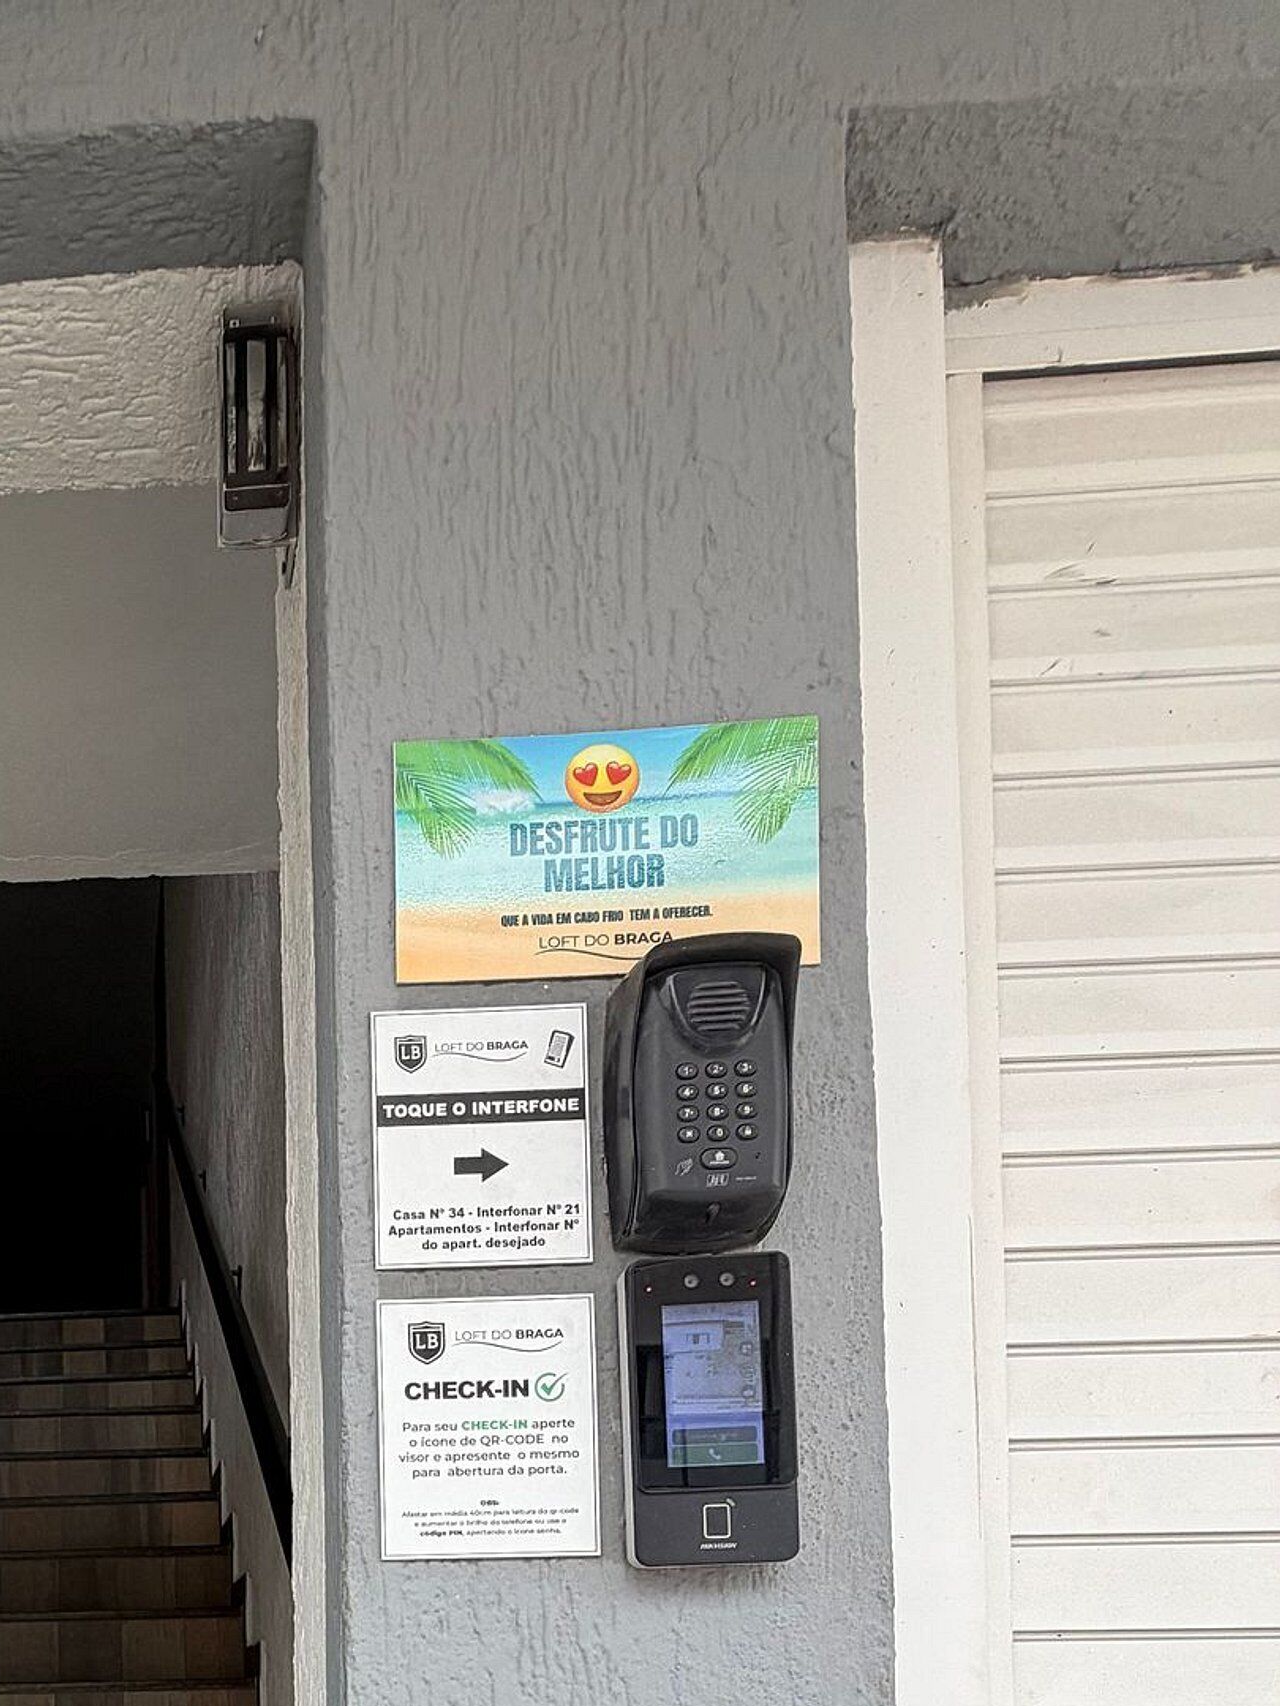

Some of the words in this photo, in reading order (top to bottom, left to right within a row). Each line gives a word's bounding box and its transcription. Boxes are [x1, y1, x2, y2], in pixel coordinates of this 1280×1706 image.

[510, 816, 651, 857] DESFRUTE
[660, 813, 700, 849] DO
[543, 853, 666, 893] MELHOR
[501, 915, 520, 927] QUE
[521, 914, 529, 926] A
[531, 912, 553, 926] VIDA
[556, 911, 571, 925] EM
[573, 910, 600, 924] CABO
[602, 909, 624, 923] FRIO
[630, 907, 650, 921] TEM
[652, 907, 660, 920] A
[662, 904, 714, 919] OFERECER.
[538, 935, 580, 949] LOFT
[584, 934, 610, 947] DO
[614, 931, 673, 945] BRAGA
[400, 1045, 420, 1061] LB
[434, 1042, 463, 1052] LOFT
[466, 1042, 484, 1051] DO
[486, 1040, 529, 1050] BRAGA
[382, 1103, 447, 1119] TOQUE
[452, 1104, 466, 1116] O
[472, 1098, 580, 1116] INTERFONE
[393, 1209, 425, 1221] Casa
[448, 1207, 465, 1219] 34
[477, 1205, 543, 1218] Interfonar
[565, 1203, 581, 1215] 21
[388, 1223, 482, 1238] Apartamentos
[494, 1220, 560, 1233] Interfonar
[422, 1239, 438, 1251] do
[442, 1238, 482, 1252] apart.
[485, 1235, 546, 1250] desejado
[415, 1333, 439, 1350] LB
[454, 1330, 486, 1342] LOFT
[491, 1329, 512, 1340] DO
[515, 1328, 565, 1340] BRAGA
[404, 1378, 530, 1401] CHECK-IN
[402, 1421, 431, 1433] Para
[434, 1422, 458, 1432] seu
[461, 1419, 528, 1431] CHECK-IN
[531, 1418, 575, 1431] aperte
[409, 1438, 418, 1447] o
[459, 1436, 477, 1446] de
[480, 1433, 545, 1446] QR-CODE
[551, 1434, 569, 1444] no
[398, 1451, 430, 1463] visor
[433, 1453, 442, 1462] e
[444, 1450, 511, 1463] apresente
[517, 1450, 526, 1460] o
[529, 1449, 580, 1459] mesmo
[412, 1468, 441, 1479] para
[447, 1464, 504, 1476] abertura
[507, 1464, 524, 1475] da
[528, 1464, 567, 1476] porta.
